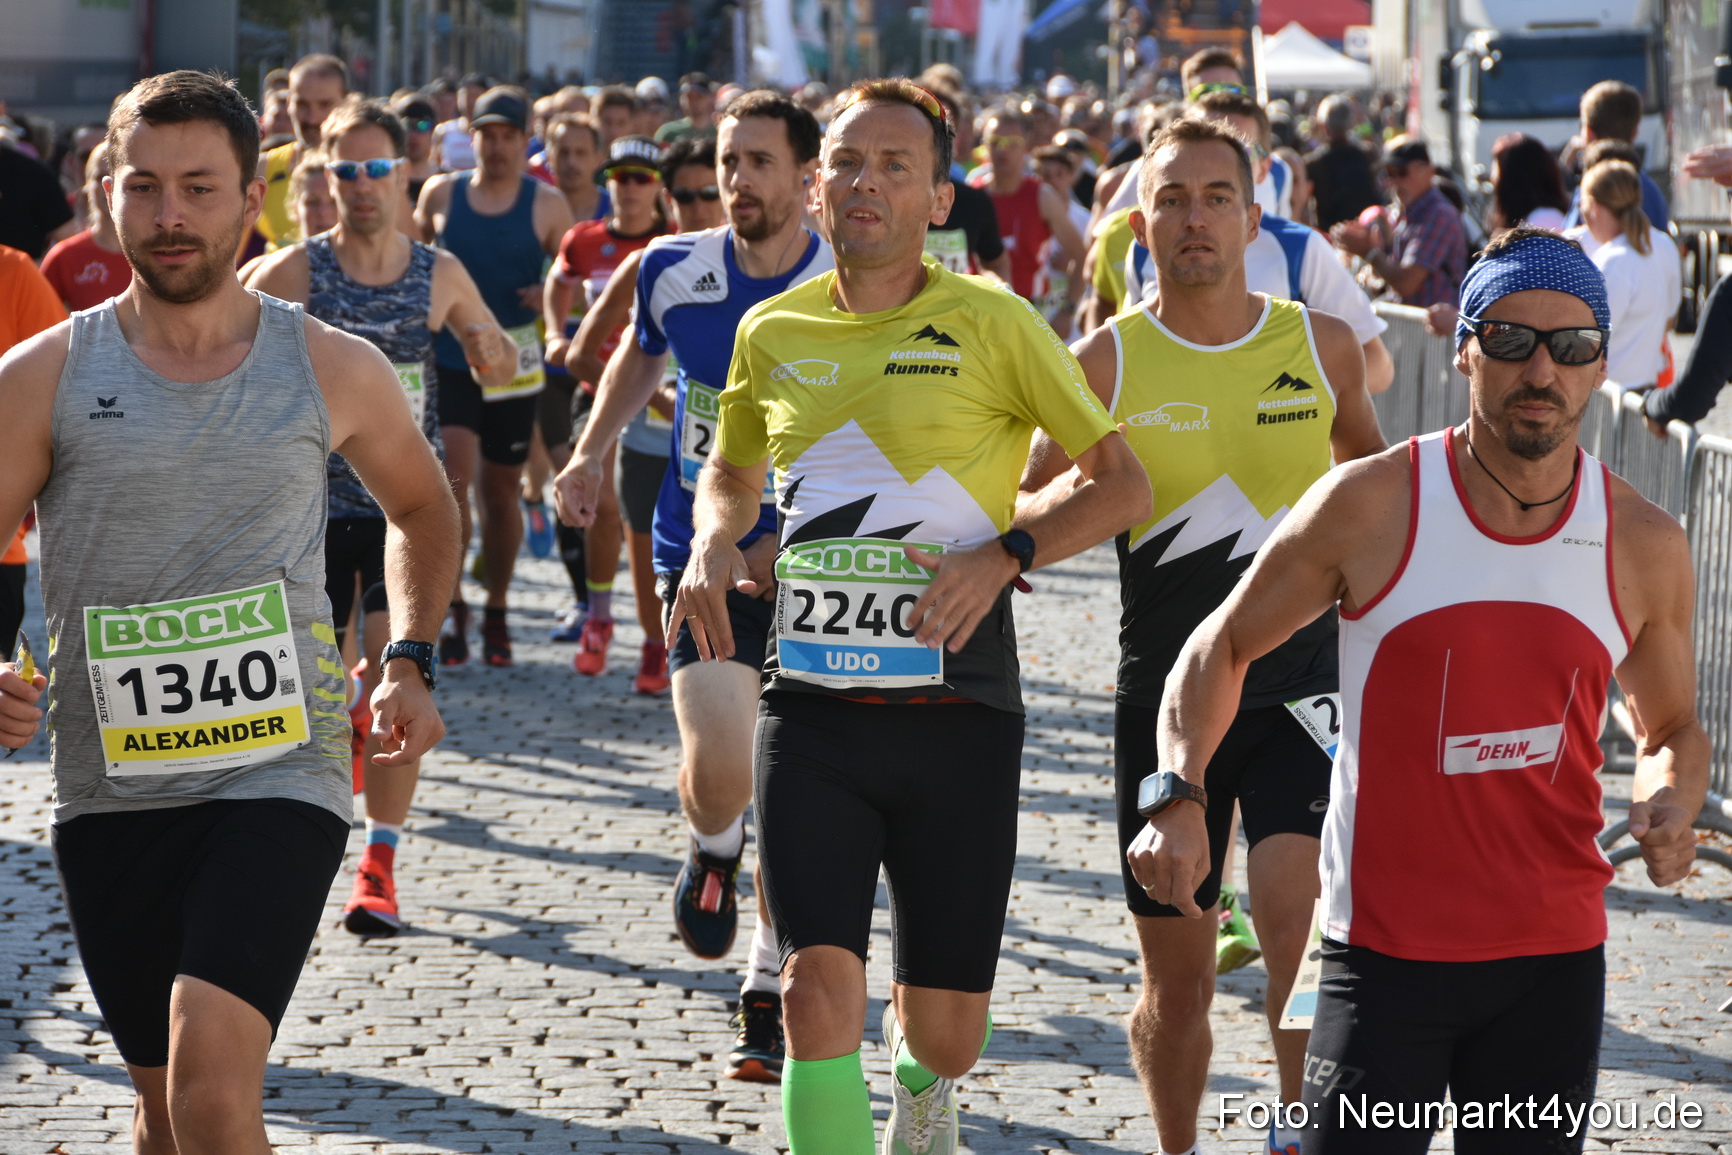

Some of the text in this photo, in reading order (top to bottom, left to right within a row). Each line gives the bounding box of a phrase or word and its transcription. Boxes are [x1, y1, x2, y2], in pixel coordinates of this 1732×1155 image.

[692, 284, 720, 292] adidas
[890, 350, 961, 362] Kettenbach
[884, 362, 959, 377] Runners
[1257, 394, 1317, 410] Kettenbach
[89, 409, 124, 419] erima
[1257, 409, 1318, 425] Runners
[1170, 420, 1211, 432] MARX
[694, 424, 710, 457] 2
[789, 545, 929, 579] BOCK
[102, 594, 272, 651] BOCK
[793, 589, 921, 638] 2240
[279, 649, 288, 659] A
[826, 652, 880, 671] UDO
[116, 650, 277, 716] 1340
[1311, 696, 1340, 735] 2
[124, 715, 287, 752] ALEXANDER
[1476, 740, 1531, 762] DEHN
[1304, 1055, 1366, 1098] cep
